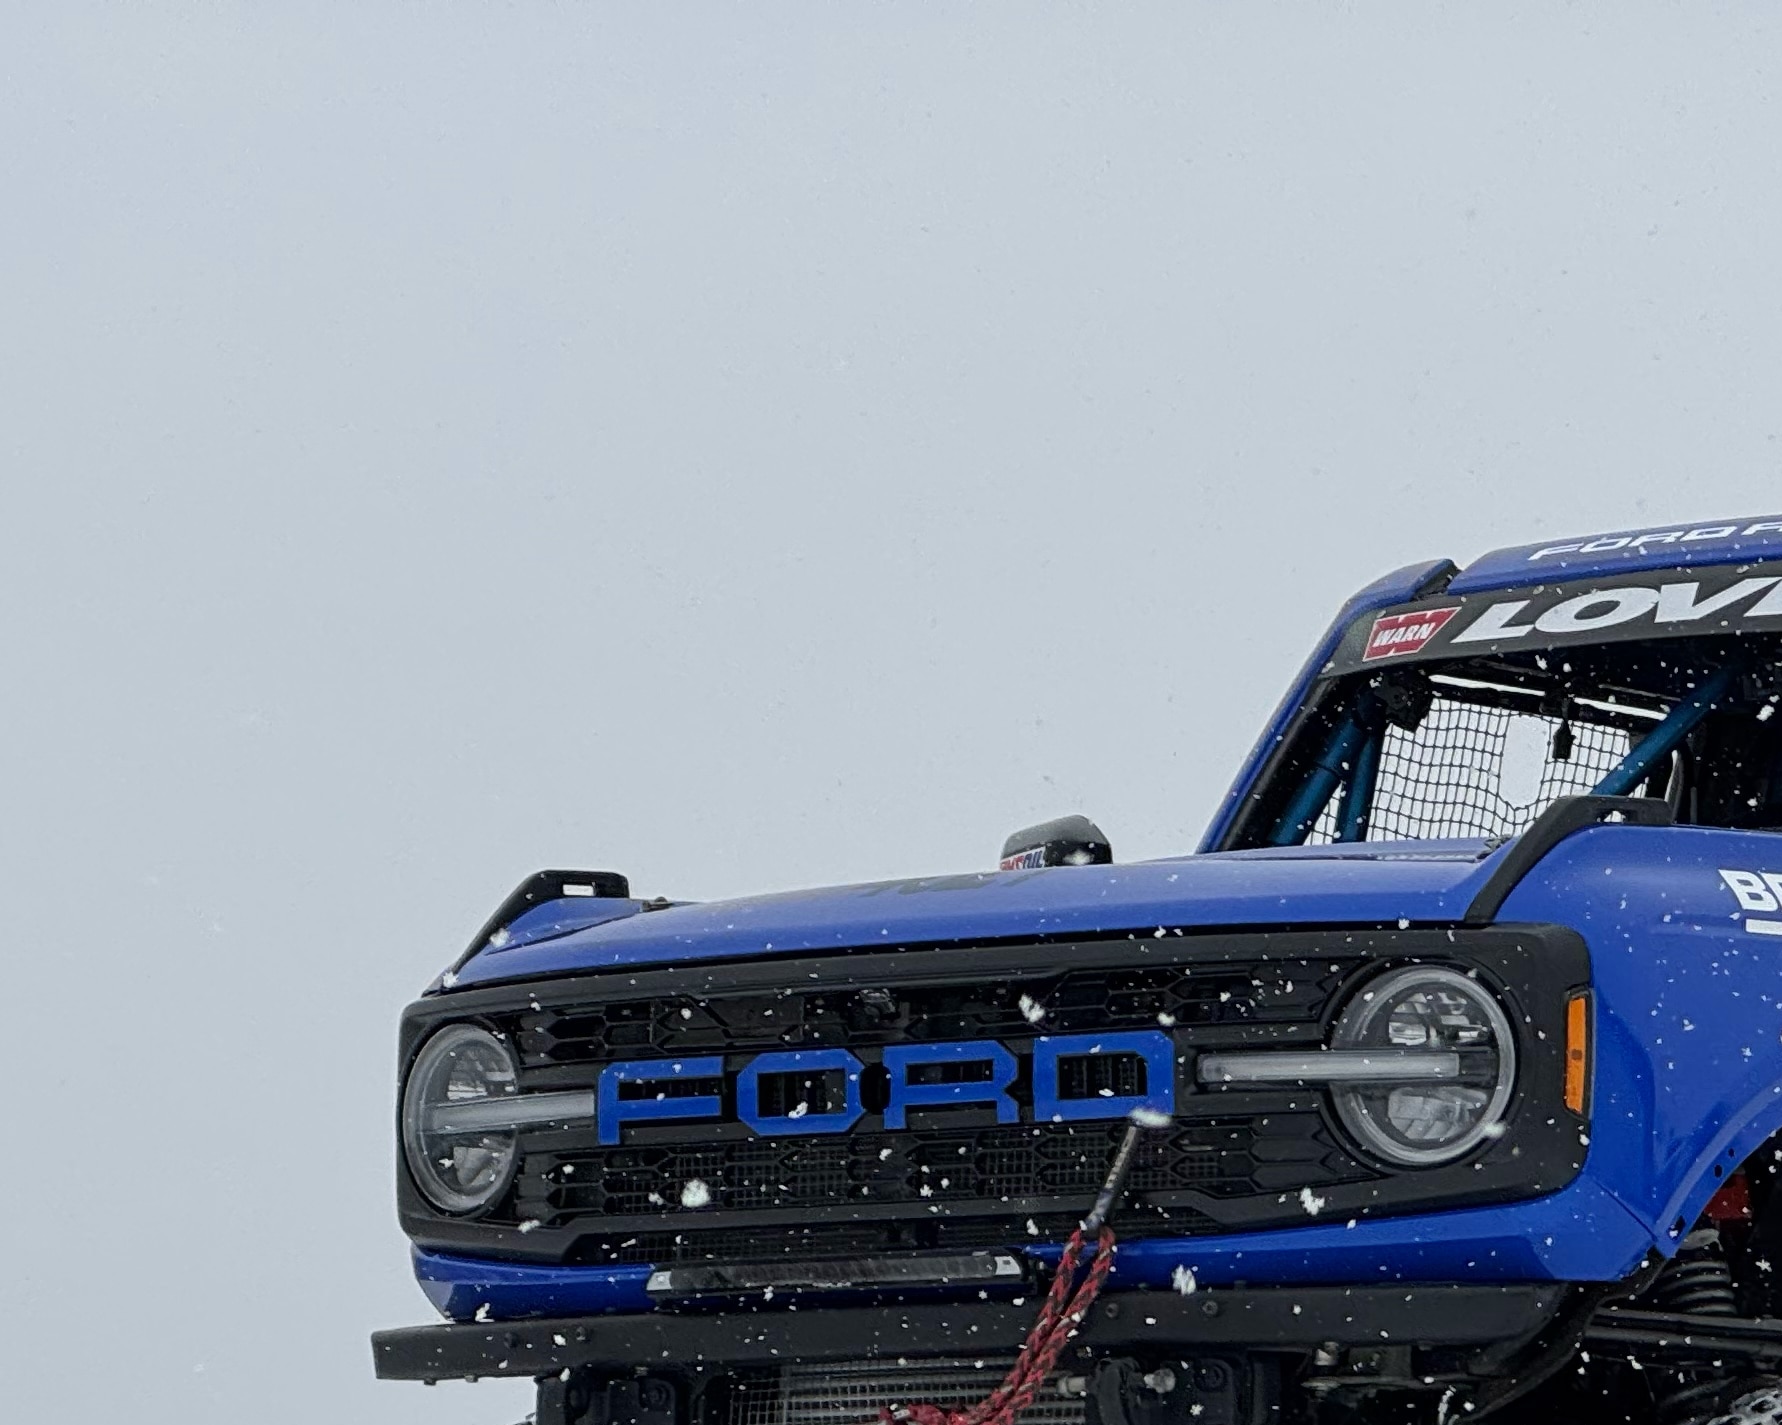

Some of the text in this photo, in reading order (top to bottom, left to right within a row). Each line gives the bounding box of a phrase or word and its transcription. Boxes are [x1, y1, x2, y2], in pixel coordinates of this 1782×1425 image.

[1528, 526, 1740, 561] FORD
[1373, 622, 1434, 648] WARN
[599, 1030, 1175, 1146] FORD
